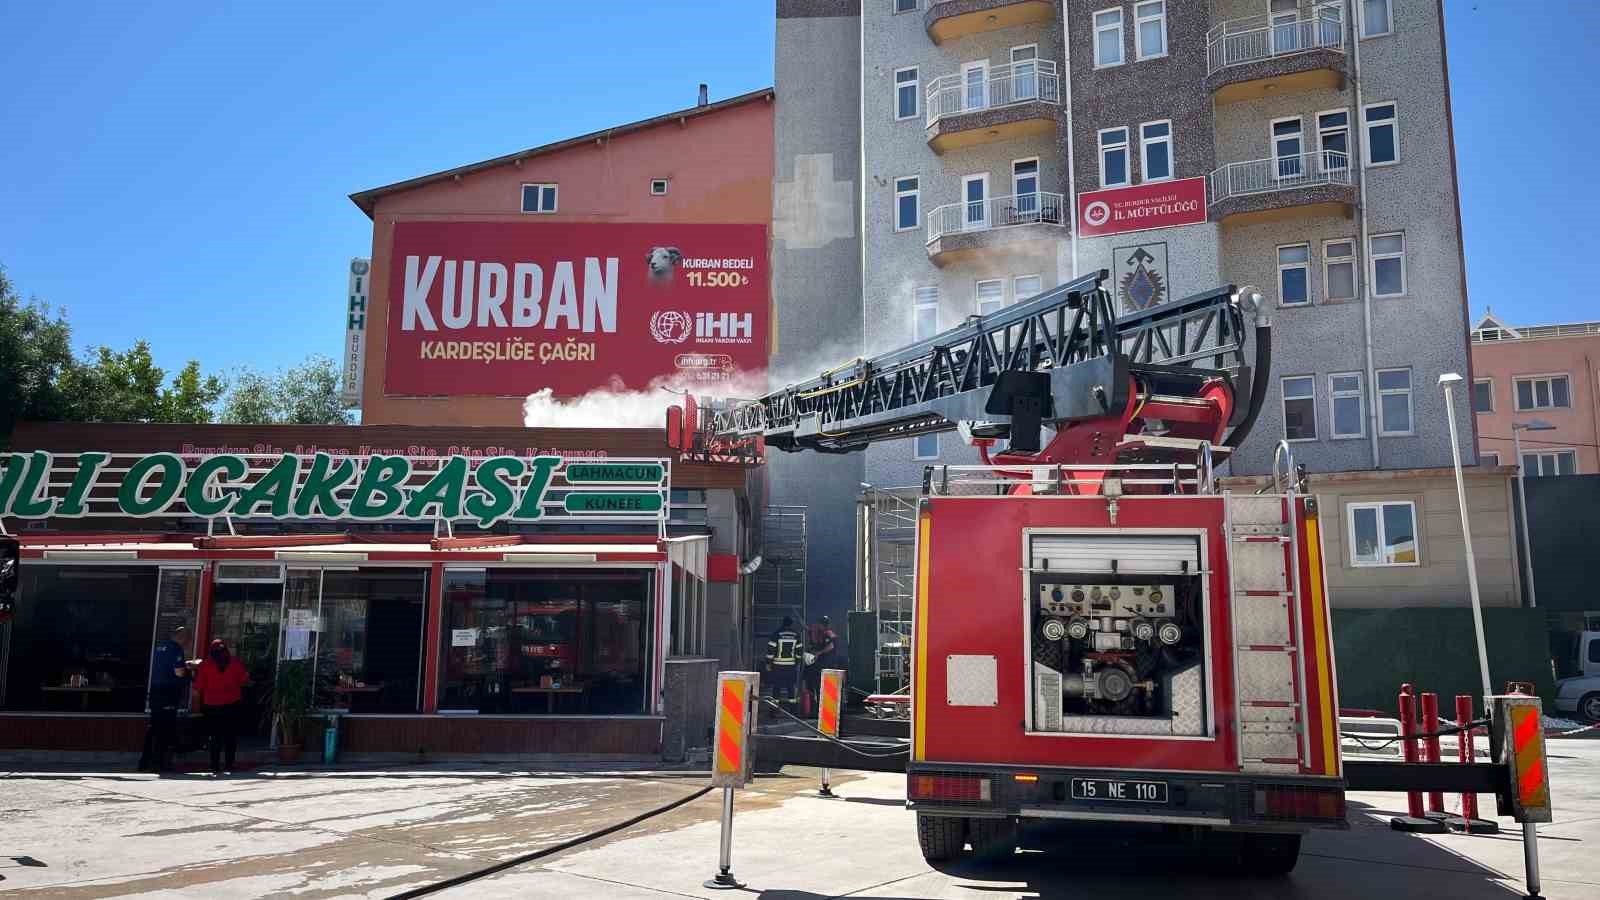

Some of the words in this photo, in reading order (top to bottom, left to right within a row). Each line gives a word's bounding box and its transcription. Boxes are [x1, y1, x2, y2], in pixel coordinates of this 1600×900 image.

[1127, 199, 1198, 220] MÜFTÜLÜĞÜ
[682, 258, 721, 269] KURBAN
[722, 257, 753, 269] BEDELİ
[402, 255, 620, 333] KURBAN
[420, 337, 535, 364] KARDEŞLİĞE
[539, 336, 596, 366] ÇAĞRI
[572, 466, 657, 480] LAHMACUN
[118, 452, 563, 528] OCAKBAŞI
[1081, 781, 1096, 797] 15
[1108, 782, 1126, 798] NE
[1135, 783, 1157, 799] 110
